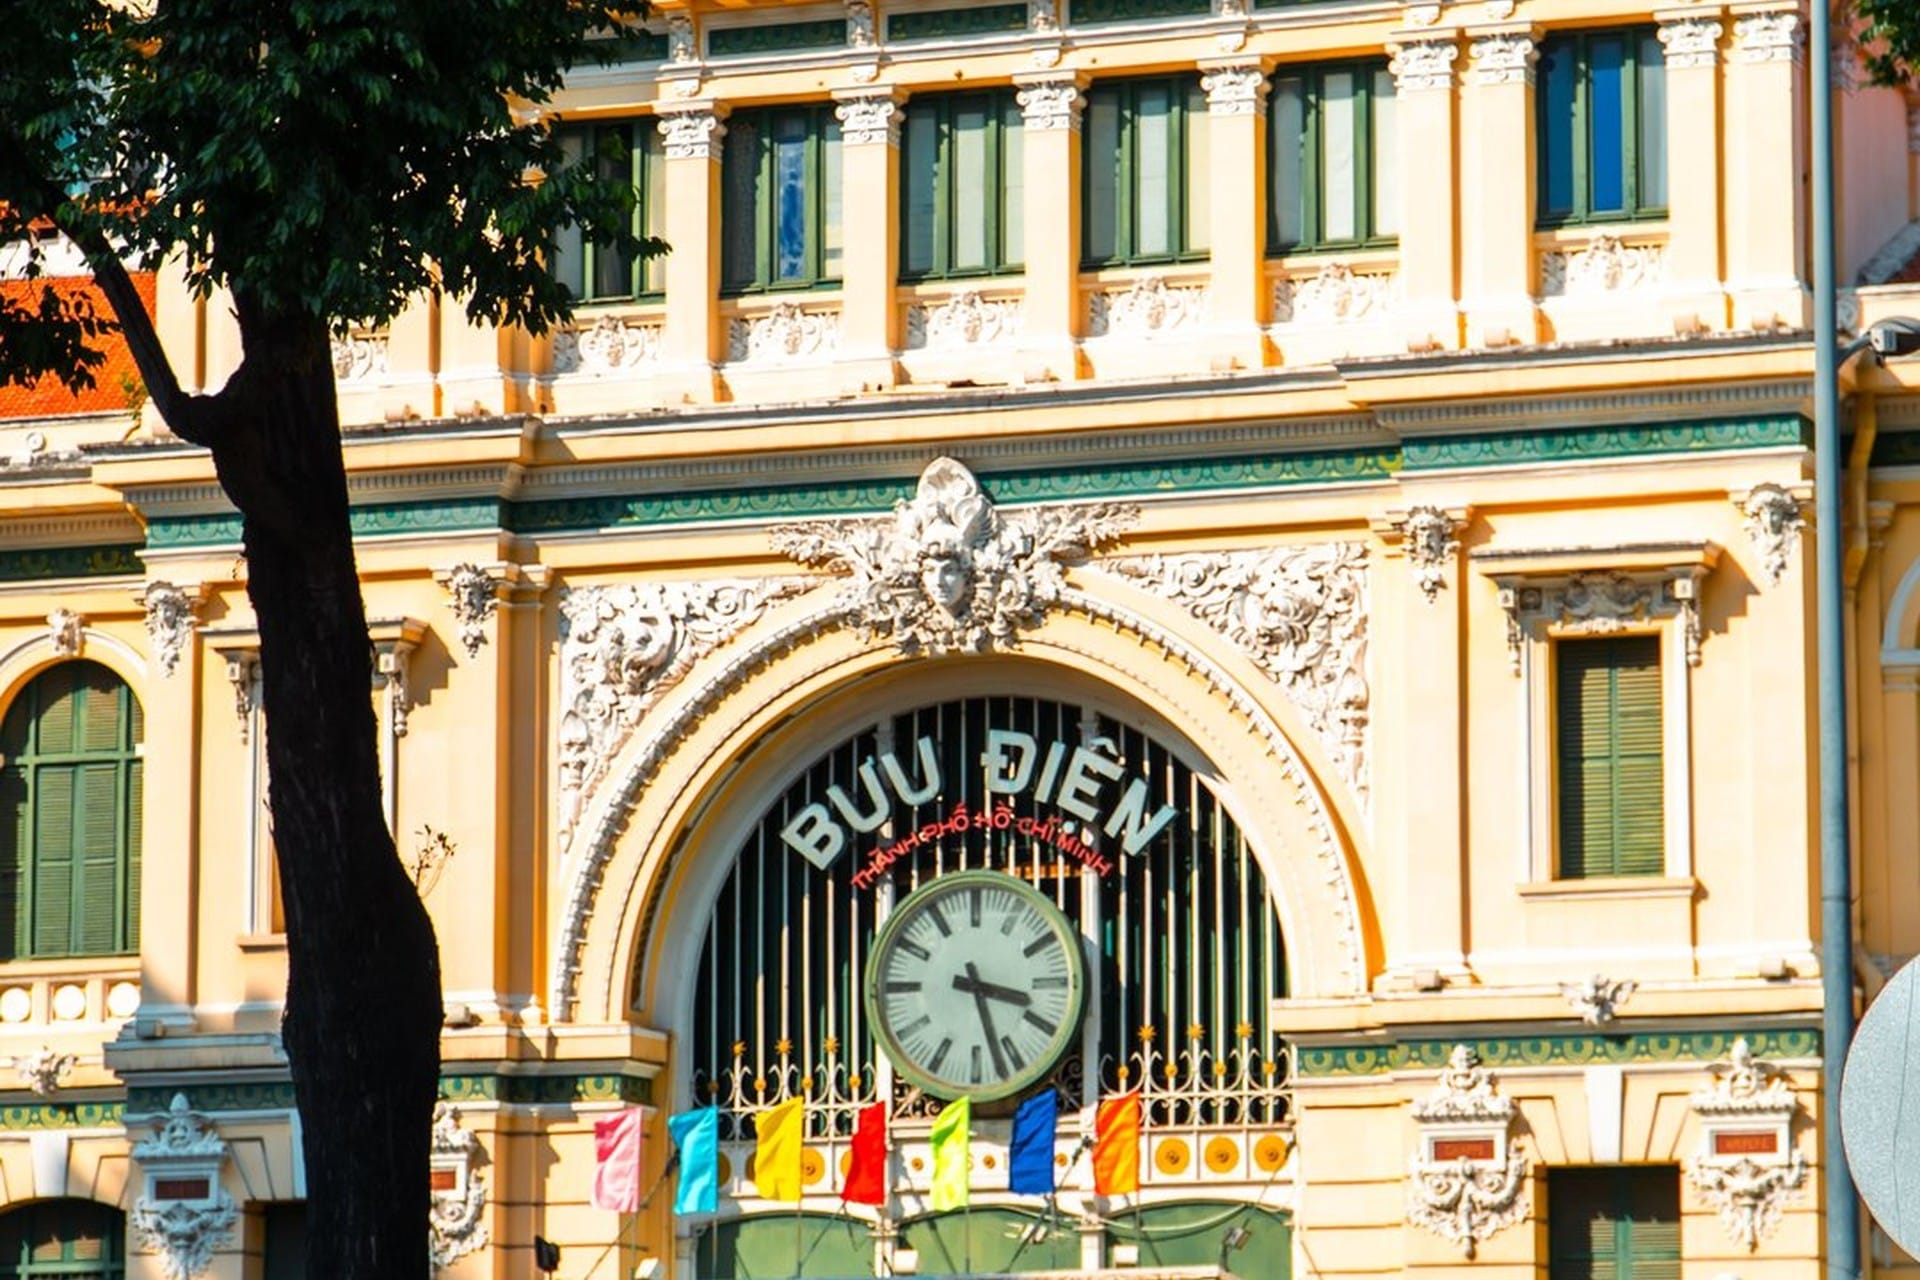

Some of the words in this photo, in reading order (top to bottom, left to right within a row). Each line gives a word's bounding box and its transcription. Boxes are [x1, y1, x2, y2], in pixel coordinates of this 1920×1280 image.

[780, 735, 942, 871] BƯU
[980, 728, 1179, 857] ĐIỆN
[851, 831, 921, 890] THÀNH
[1056, 833, 1113, 878] MINH
